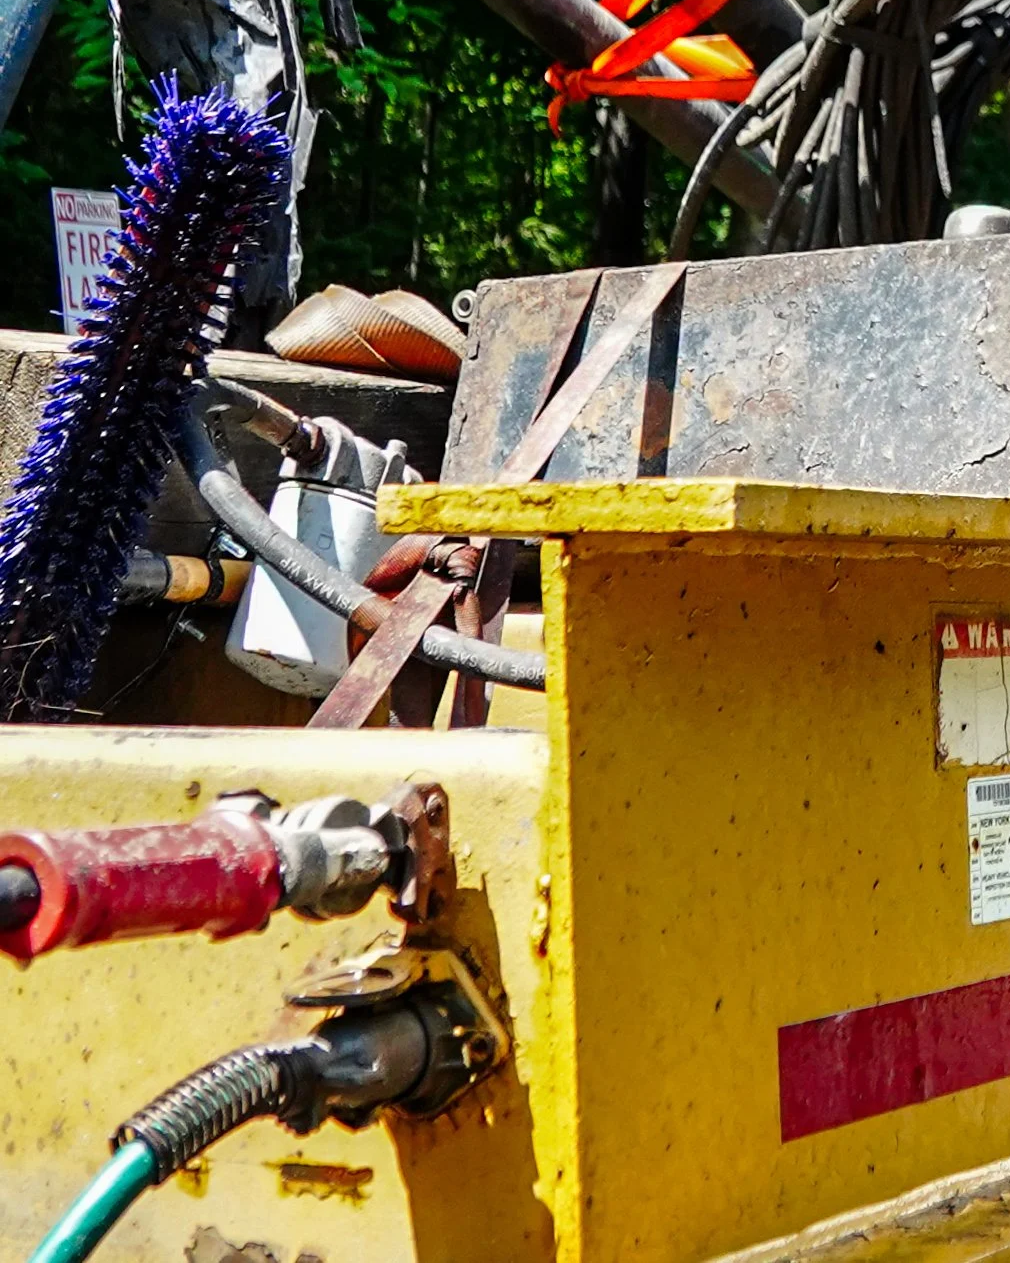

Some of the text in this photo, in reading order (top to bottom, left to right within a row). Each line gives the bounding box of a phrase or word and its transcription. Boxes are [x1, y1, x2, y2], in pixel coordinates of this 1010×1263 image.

[56, 196, 115, 221] NO PARKING
[303, 572, 335, 600] MAX
[450, 651, 479, 667] SAE
[980, 818, 994, 828] NEW
[995, 816, 1010, 826] YORK
